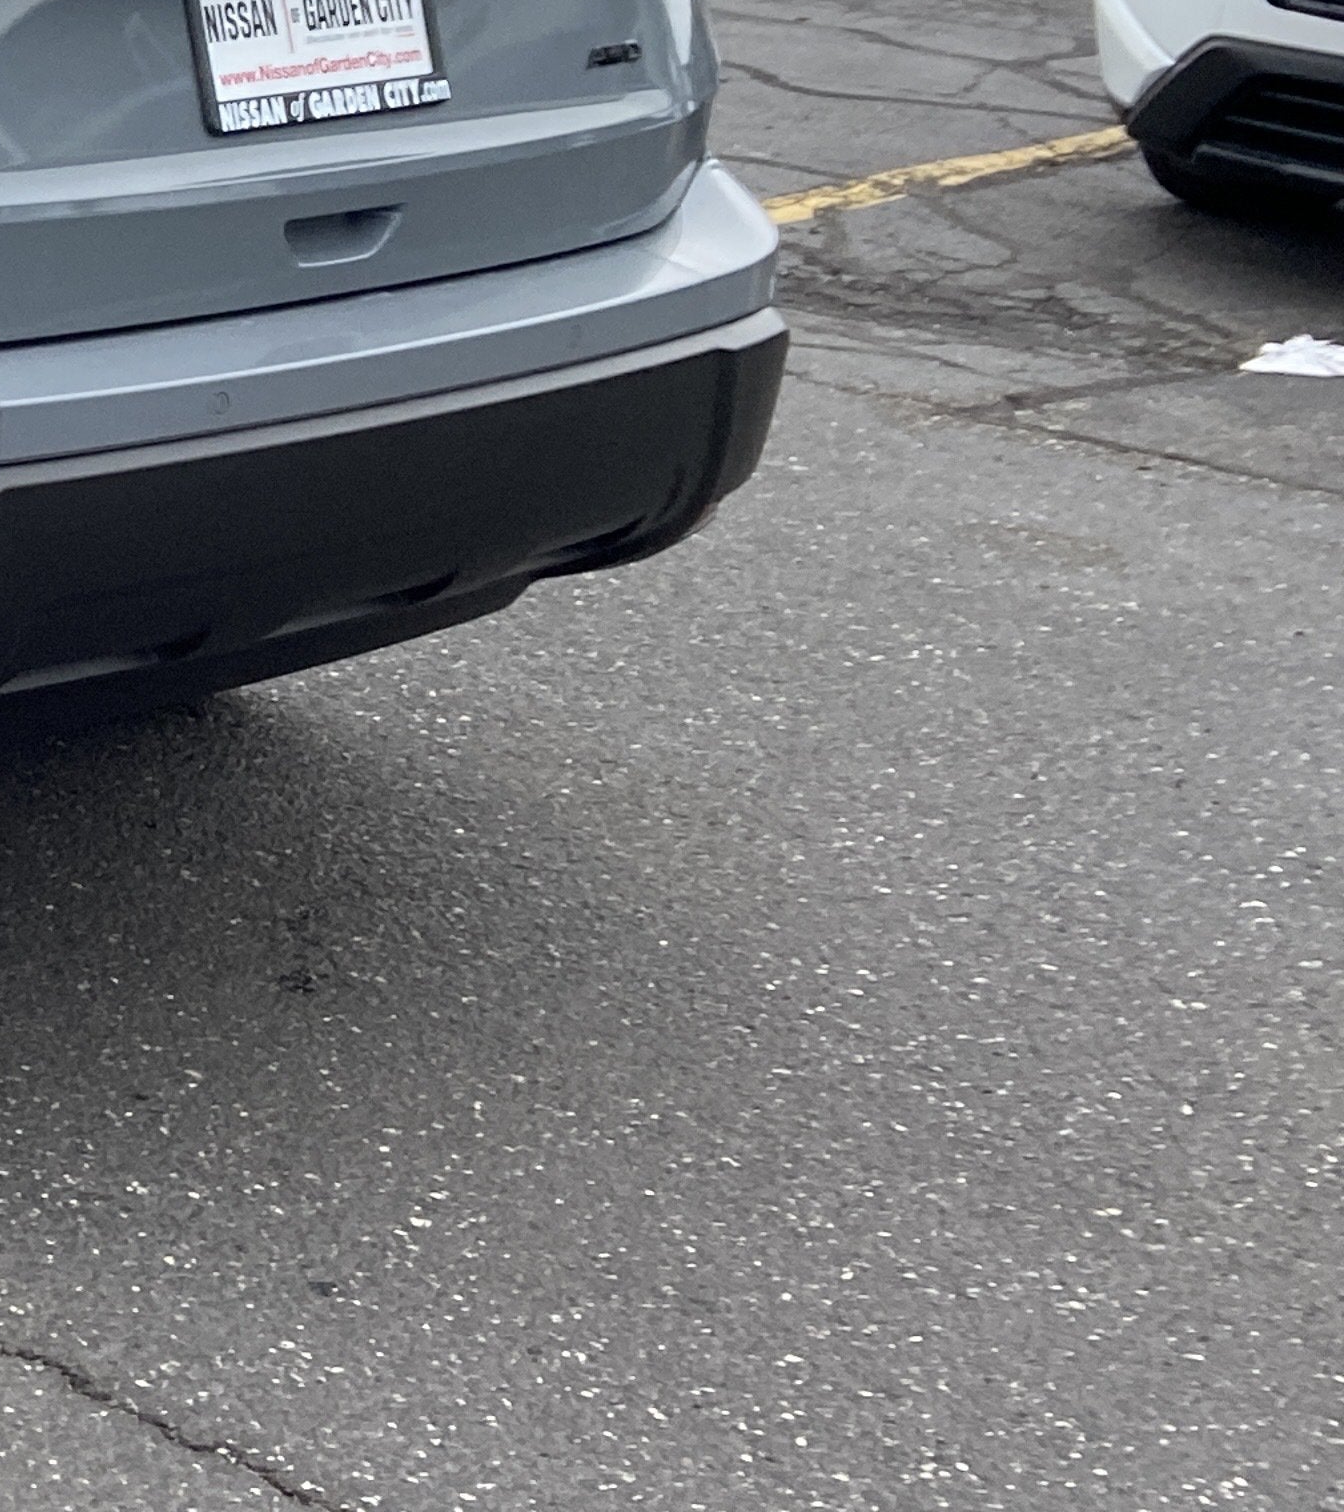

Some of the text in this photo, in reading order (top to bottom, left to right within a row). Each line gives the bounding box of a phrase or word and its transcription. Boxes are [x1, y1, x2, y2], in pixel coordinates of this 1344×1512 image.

[219, 48, 422, 87] www.NissanofGardenCity.com
[218, 96, 288, 133] NISSAN
[290, 93, 307, 122] of
[308, 83, 381, 120] GARDEN
